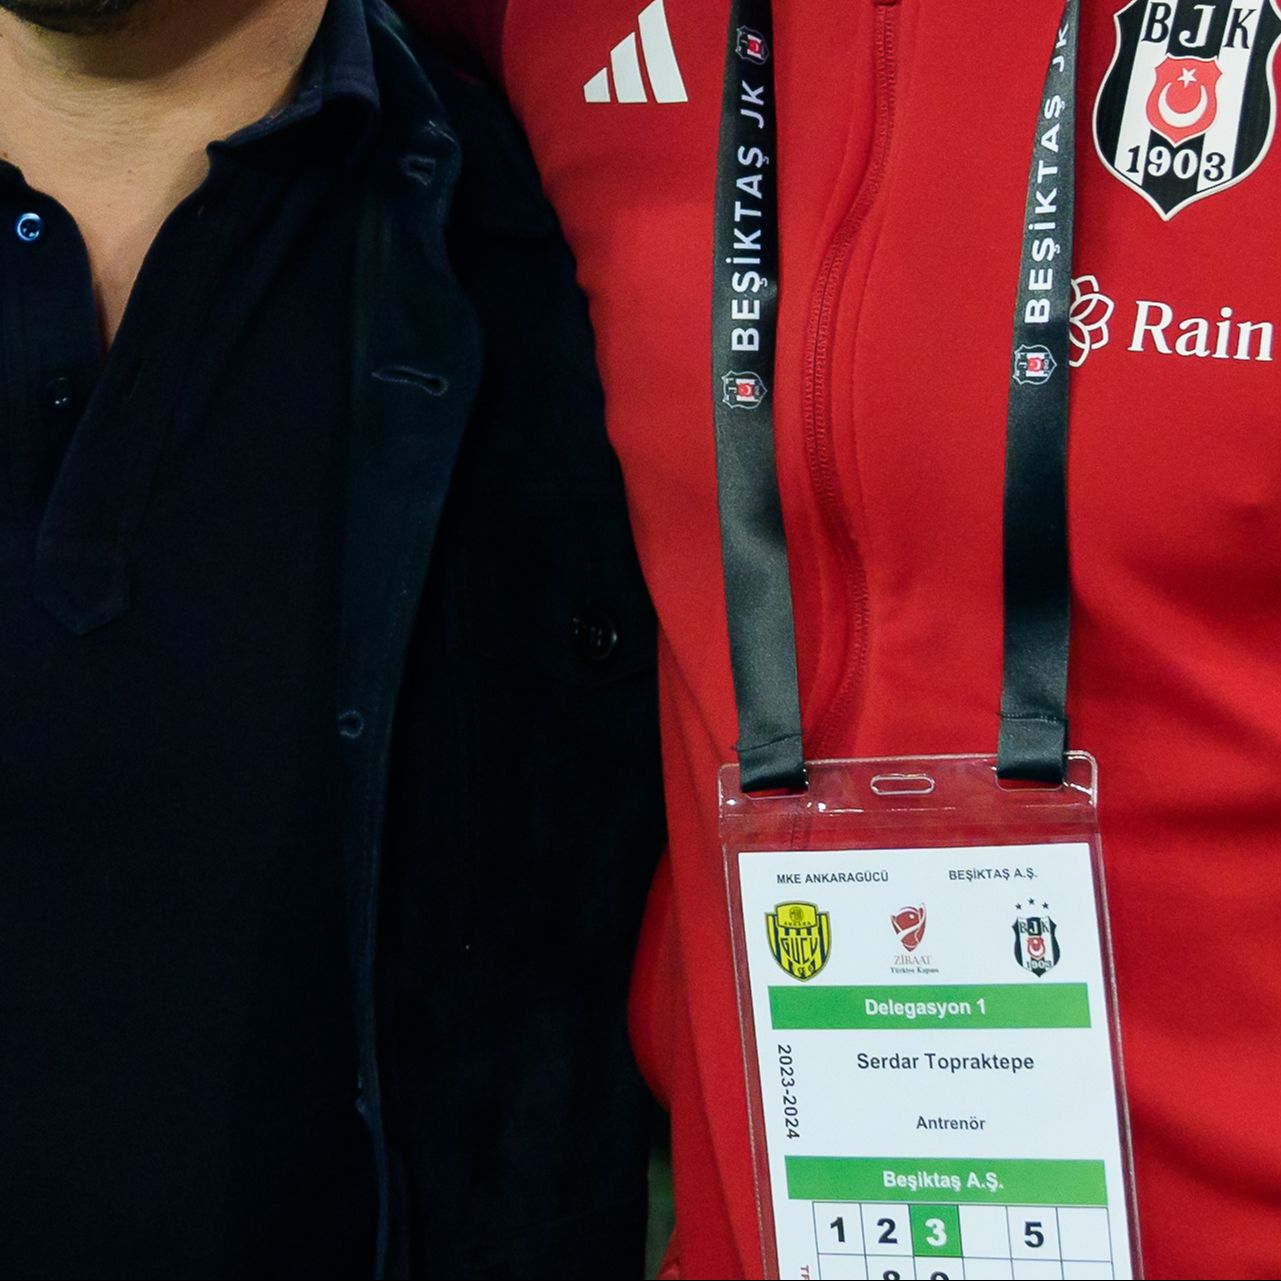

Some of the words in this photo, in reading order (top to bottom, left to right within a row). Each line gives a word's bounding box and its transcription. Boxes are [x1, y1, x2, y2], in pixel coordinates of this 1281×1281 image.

[1141, 1, 1254, 49] BJK
[740, 80, 765, 129] JK
[1125, 145, 1227, 182] 1903
[1024, 93, 1066, 325] BEŞİKTAŞ
[724, 144, 769, 352] BEŞİKTAŞ
[1127, 300, 1274, 362] Rain
[776, 873, 802, 884] MKE
[805, 870, 889, 883] ANKARAGÜCÜ
[948, 868, 1010, 882] BEŞİKTAŞ
[1013, 867, 1038, 880] A.Ş.
[864, 998, 971, 1019] Delegasyon
[976, 998, 986, 1014] 1
[856, 1052, 919, 1070] Serdar
[924, 1052, 1035, 1074] Topraktepe
[777, 1044, 801, 1140] 2023-2024
[915, 1115, 987, 1131] Antrenör
[882, 1170, 962, 1192] Beşiktaş
[966, 1171, 1005, 1194] A.Ş.
[829, 1216, 846, 1243] 1
[876, 1218, 899, 1245] 2
[925, 1218, 948, 1248] 3
[1023, 1221, 1045, 1249] 5
